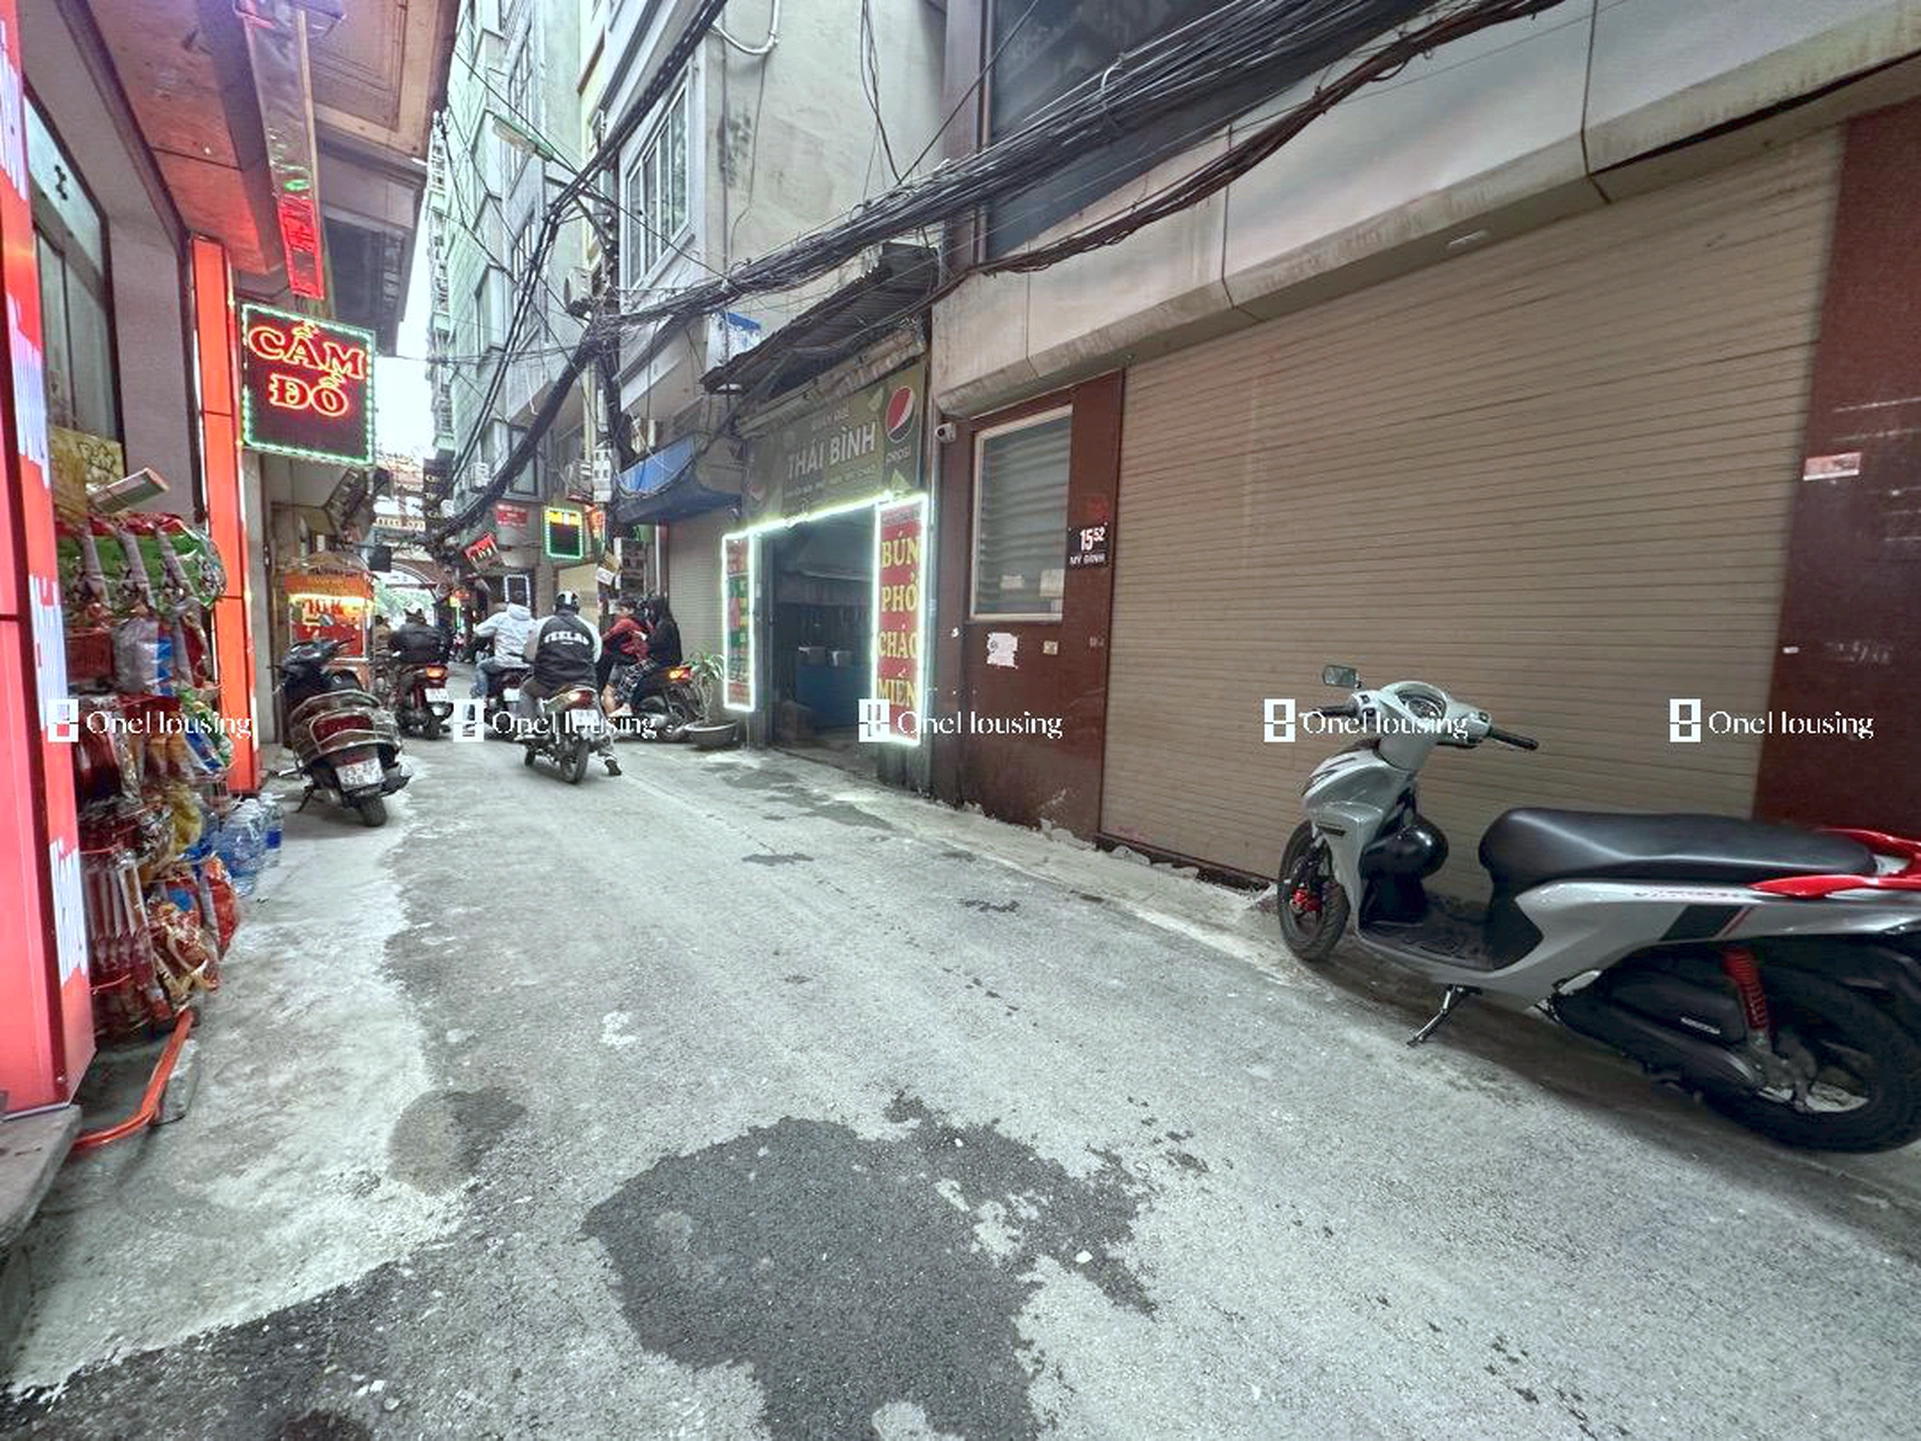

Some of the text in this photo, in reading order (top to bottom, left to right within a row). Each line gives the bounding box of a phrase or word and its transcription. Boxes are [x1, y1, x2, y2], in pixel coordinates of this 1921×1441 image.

[248, 320, 366, 380] CẦM
[269, 371, 349, 417] ĐỒ
[829, 421, 876, 465] BÌNH
[881, 529, 920, 568] BÚN
[881, 571, 919, 613] PHỞ
[877, 623, 919, 659] CHÁO
[877, 667, 919, 709] MIẾN
